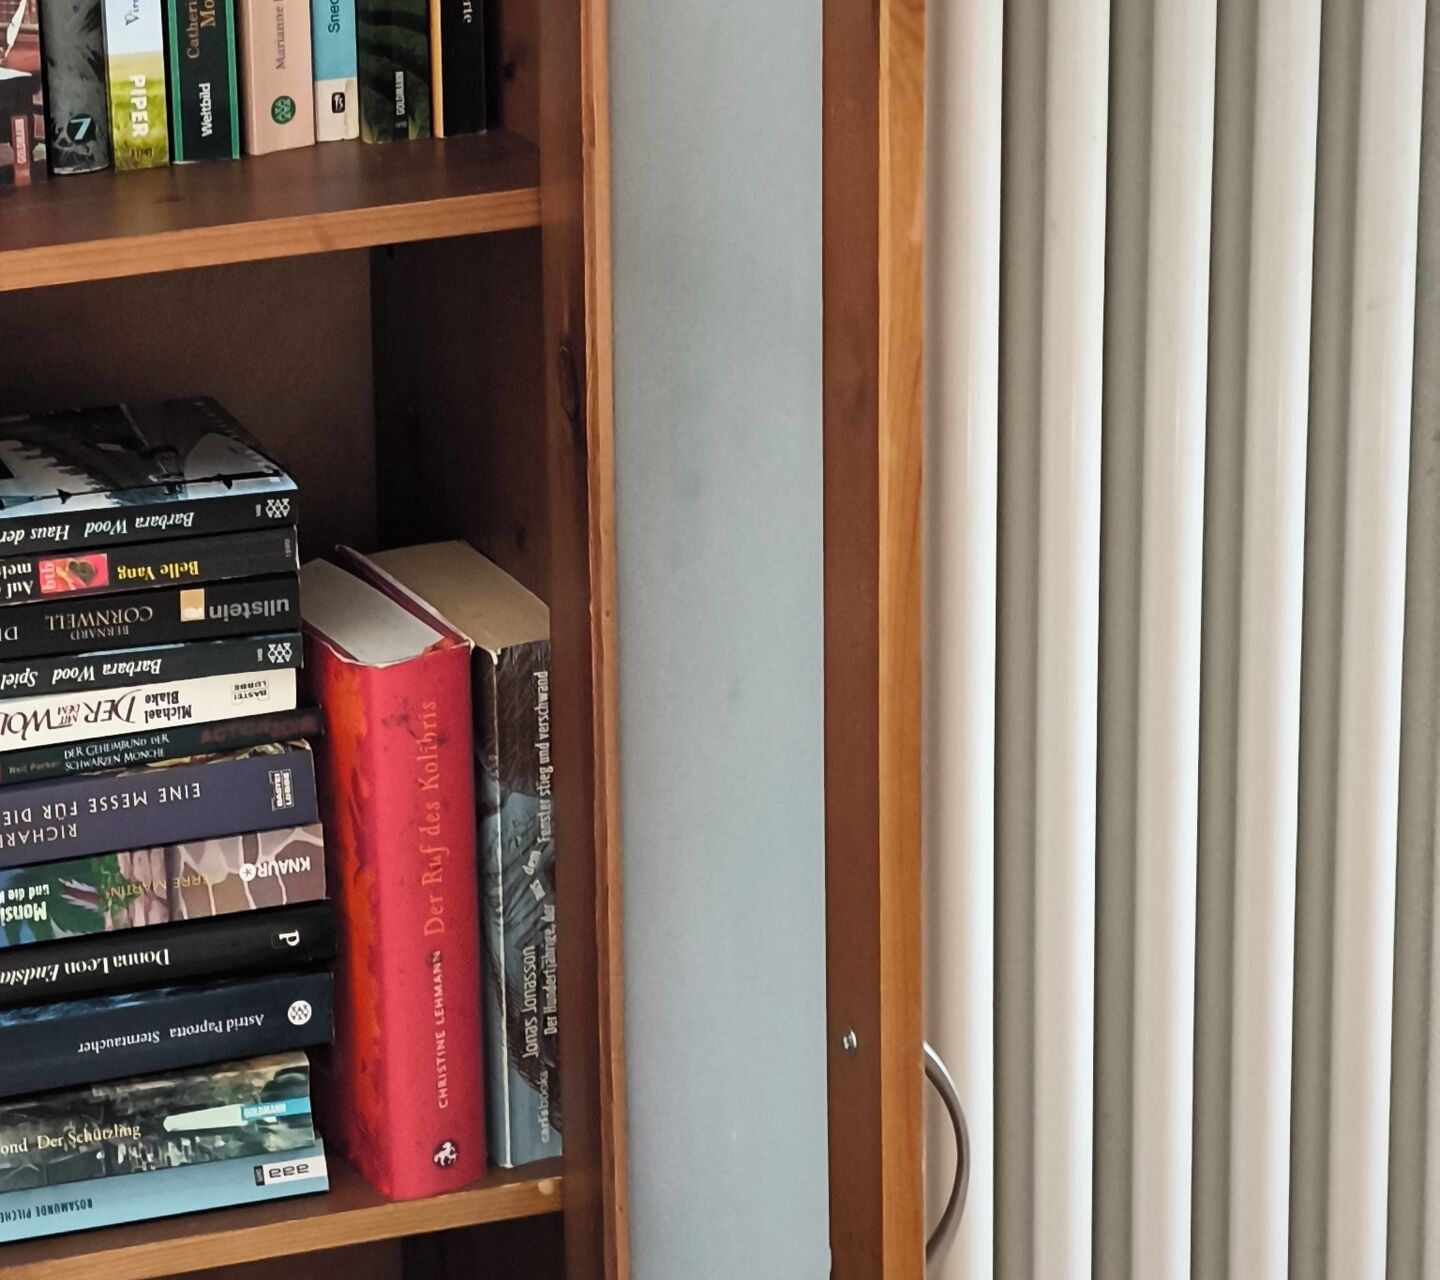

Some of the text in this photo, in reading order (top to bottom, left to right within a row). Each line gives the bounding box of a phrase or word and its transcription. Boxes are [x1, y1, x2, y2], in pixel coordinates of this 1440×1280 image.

[273, 4, 286, 70] Marianne
[128, 74, 150, 138] PIPER
[198, 82, 213, 138] Weltbild
[84, 520, 128, 535] Wood
[135, 512, 195, 529] Barbara
[0, 527, 25, 543] der
[30, 524, 70, 541] Haus
[117, 561, 200, 581] Belle Yang
[6, 579, 34, 601] Auf
[45, 605, 154, 631] CORNWELL
[209, 598, 290, 620] ullstein
[70, 625, 130, 641] BERNARD
[51, 666, 96, 685] Wood
[102, 658, 163, 677] Barbara
[0, 670, 39, 688] Spiel
[83, 689, 143, 723] DER
[144, 691, 180, 705] Blake
[144, 704, 192, 725] Michael
[533, 671, 554, 802] stieg und verschwand
[63, 738, 148, 760] DER GEHEIMBUND
[64, 754, 121, 771] SCHWARZEN
[87, 791, 148, 814] MESSE
[158, 782, 201, 803] EINE
[3, 808, 32, 826] DIE
[43, 801, 78, 822] FÜR
[256, 855, 311, 878] KNAUR
[416, 700, 450, 1109] CHRISTINE LEHMANN Der Ruf des Kolibris
[65, 956, 109, 974] Leon
[113, 949, 171, 969] Donna
[522, 945, 539, 1058] Jonas Jonasson
[78, 1014, 265, 1054] Astrid Paprotta Sterntaucher
[543, 1014, 558, 1036] Der
[37, 1134, 65, 1150] Der
[35, 1197, 93, 1217] ROSAMUNDE
